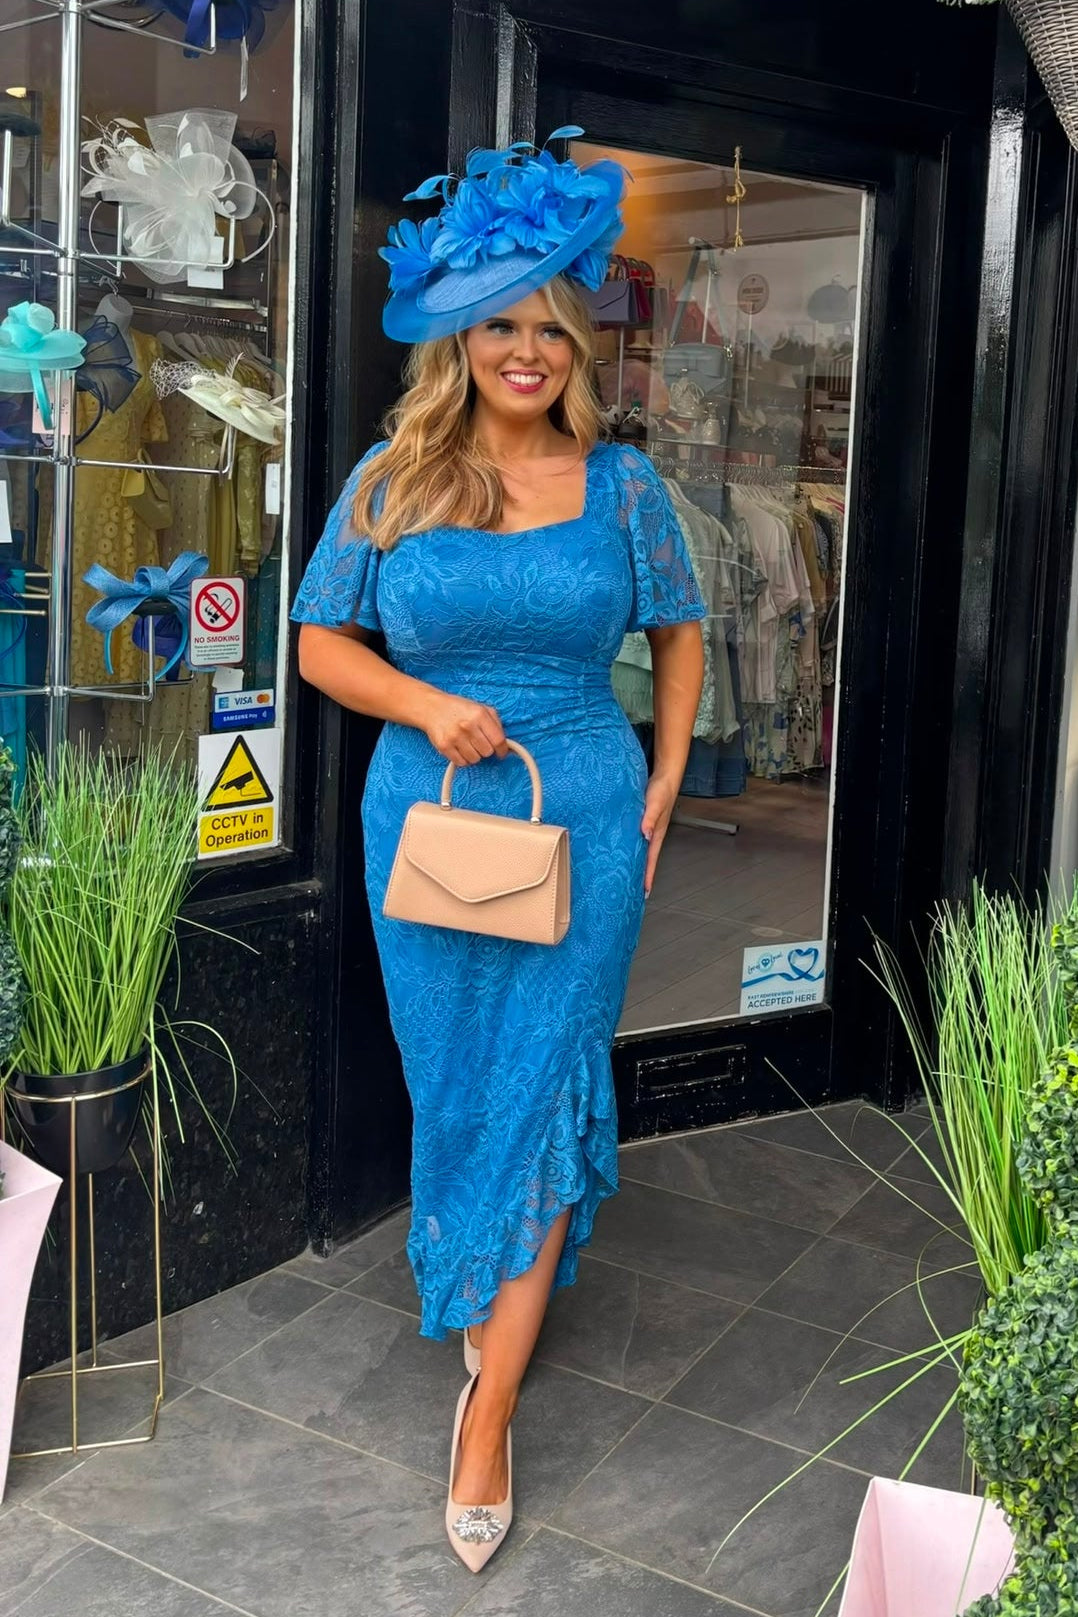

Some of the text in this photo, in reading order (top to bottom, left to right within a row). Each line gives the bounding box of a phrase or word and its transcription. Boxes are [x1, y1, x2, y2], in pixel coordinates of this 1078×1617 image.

[234, 696, 253, 705] VISA
[212, 813, 263, 830] CCTV in
[206, 828, 268, 848] Operation
[748, 994, 816, 1008] ACCEPTED HERE
